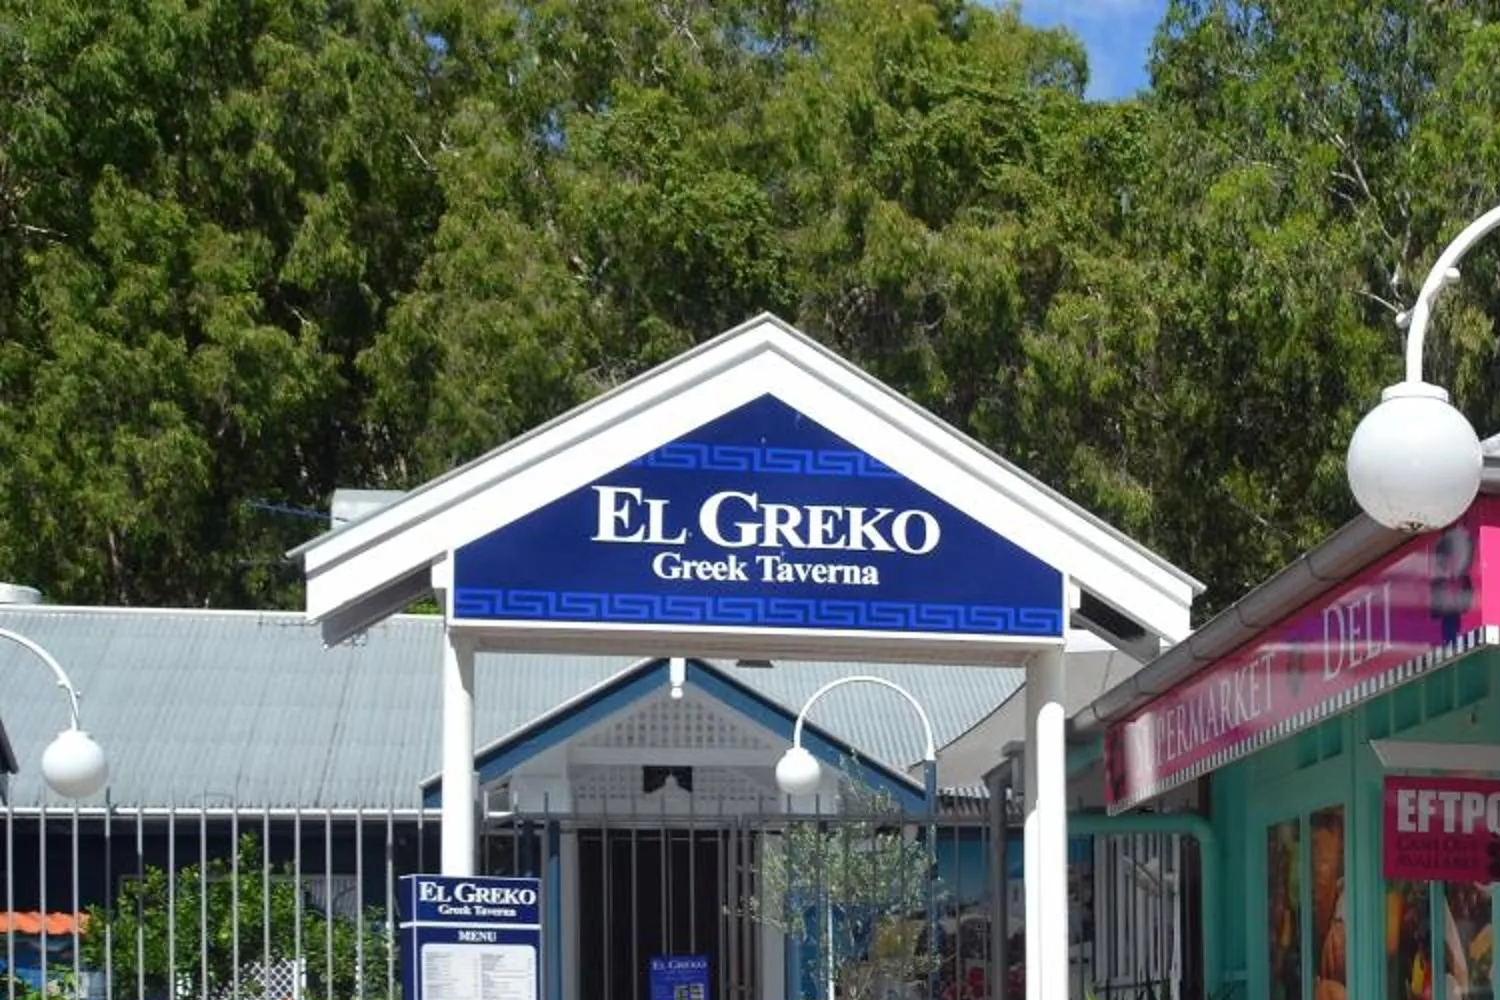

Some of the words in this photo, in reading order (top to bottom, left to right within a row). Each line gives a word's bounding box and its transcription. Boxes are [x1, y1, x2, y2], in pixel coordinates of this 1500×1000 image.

[591, 485, 687, 545] EL
[699, 491, 941, 555] GREKO
[652, 552, 748, 581] Greek
[756, 555, 879, 585] Taverna
[1323, 581, 1394, 682] DELI
[419, 881, 452, 902] EL
[454, 883, 536, 905] GREKO
[458, 931, 497, 942] MENU
